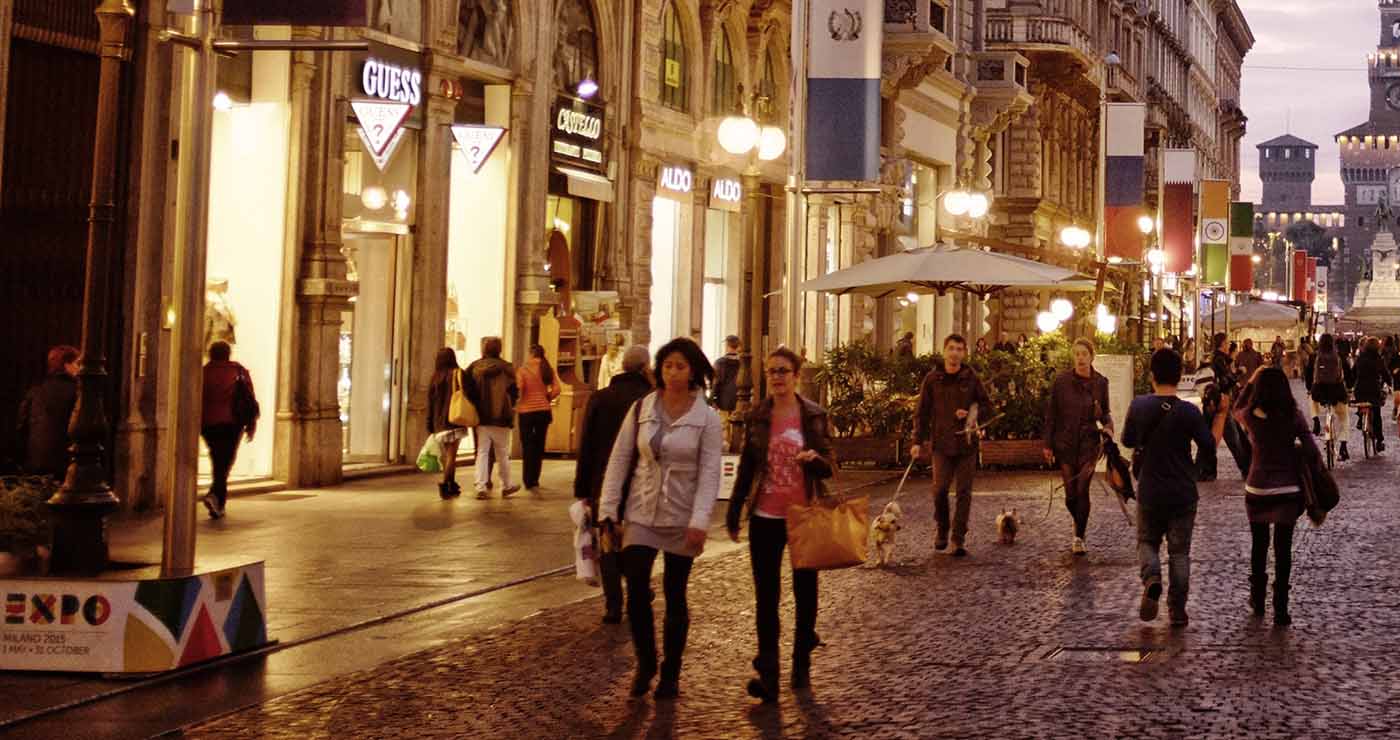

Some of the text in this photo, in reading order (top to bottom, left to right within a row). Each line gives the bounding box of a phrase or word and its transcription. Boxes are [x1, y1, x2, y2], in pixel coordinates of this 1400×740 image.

[363, 60, 421, 105] GUESS
[661, 166, 692, 192] ALDO
[713, 179, 742, 203] ALDO
[6, 593, 111, 626] EXPO
[3, 632, 66, 644] MILANO 2015
[8, 645, 26, 655] MAY
[47, 645, 90, 656] OCTOBER
